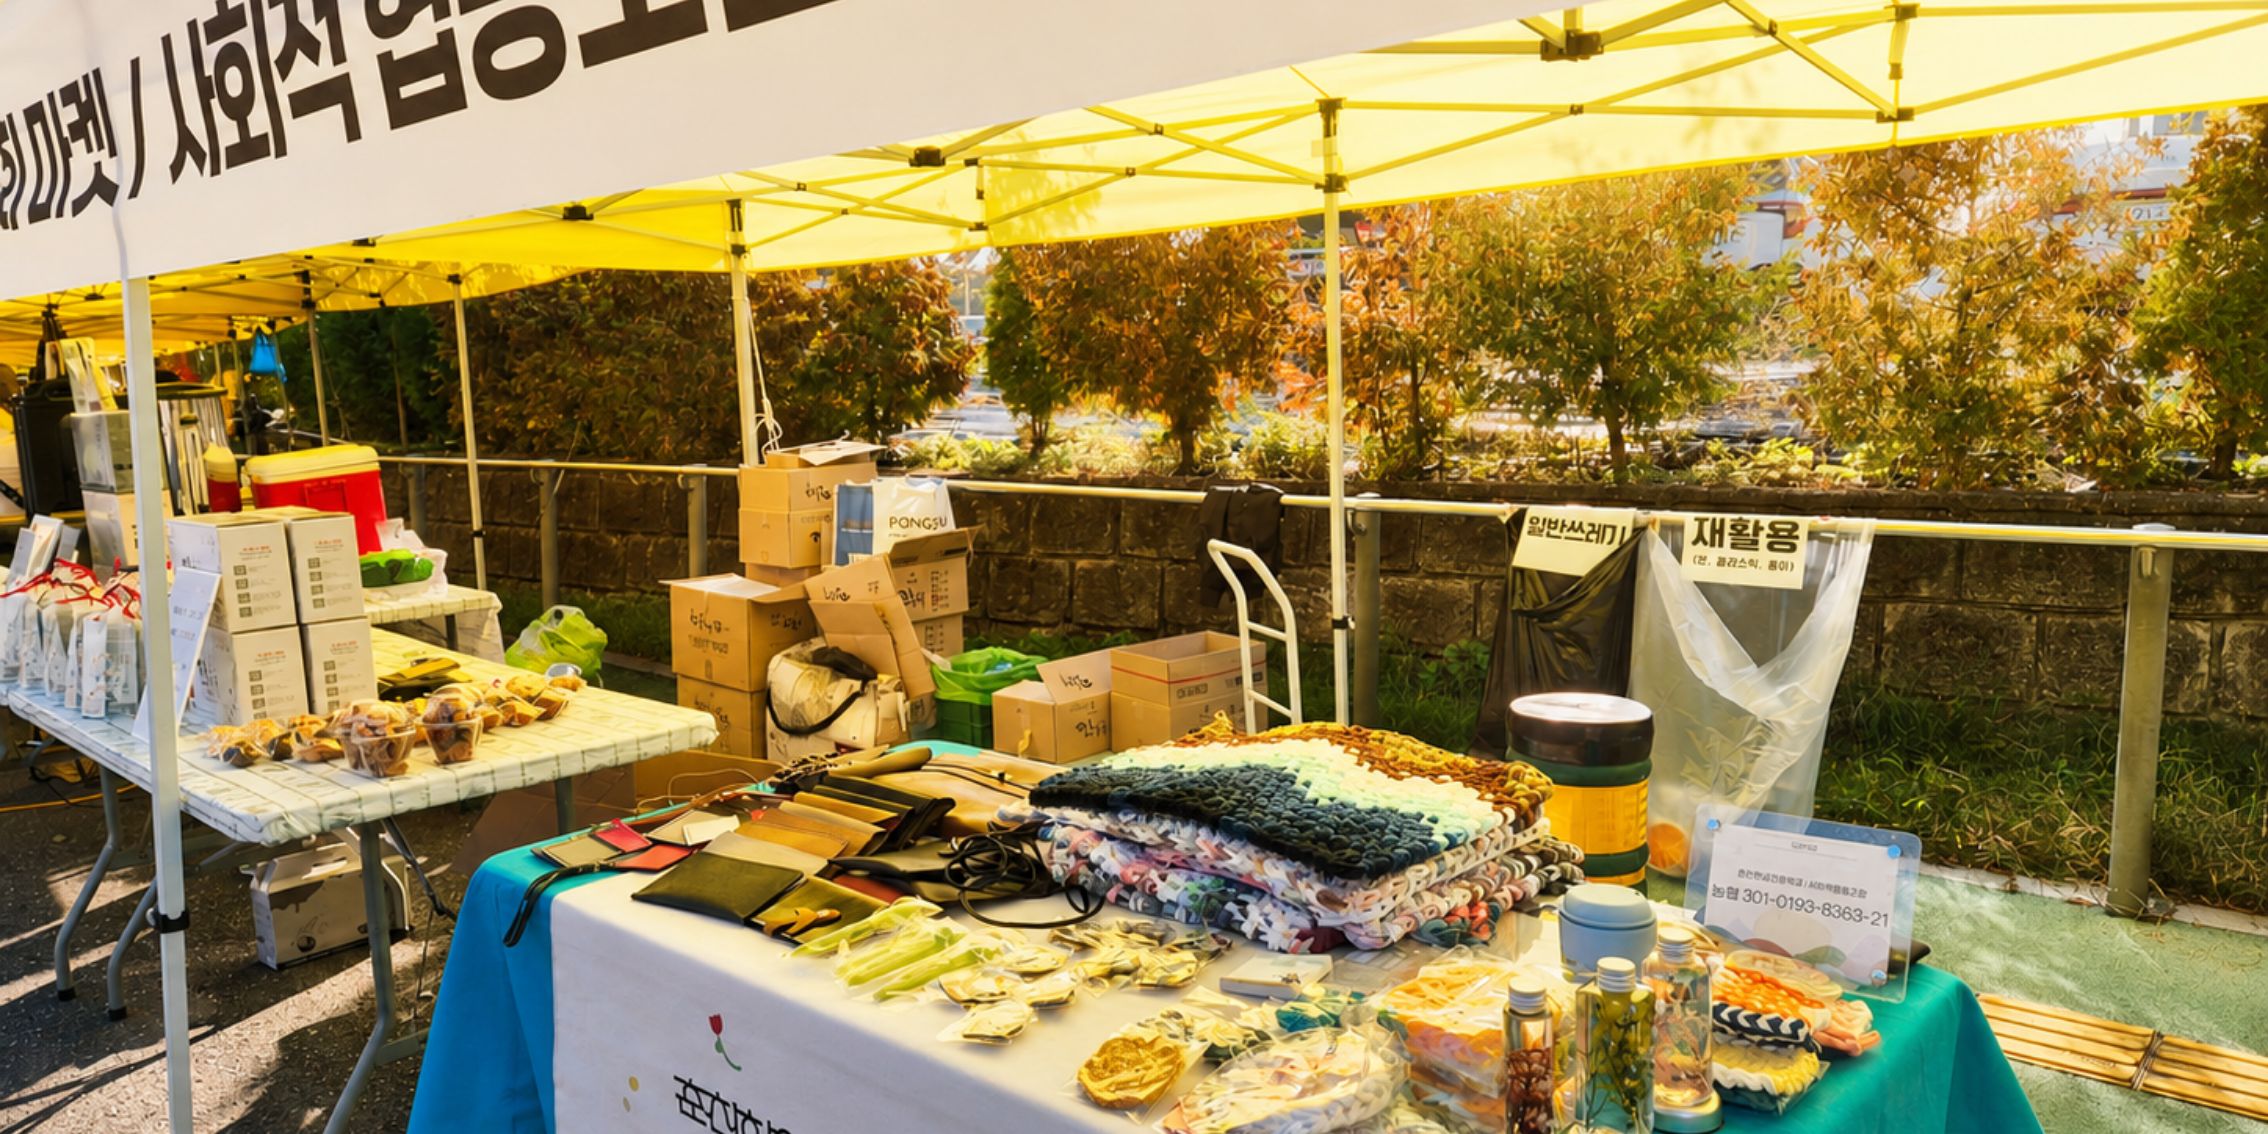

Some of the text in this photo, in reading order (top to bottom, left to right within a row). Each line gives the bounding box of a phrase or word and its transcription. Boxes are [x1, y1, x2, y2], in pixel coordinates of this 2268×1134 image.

[23, 67, 119, 224] 마켓
[161, 0, 361, 185] 사회적
[1527, 516, 1627, 546] 일반쓰레기
[1691, 516, 1800, 554] 재활용
[1742, 888, 1889, 928] 301-0193-8363-21
